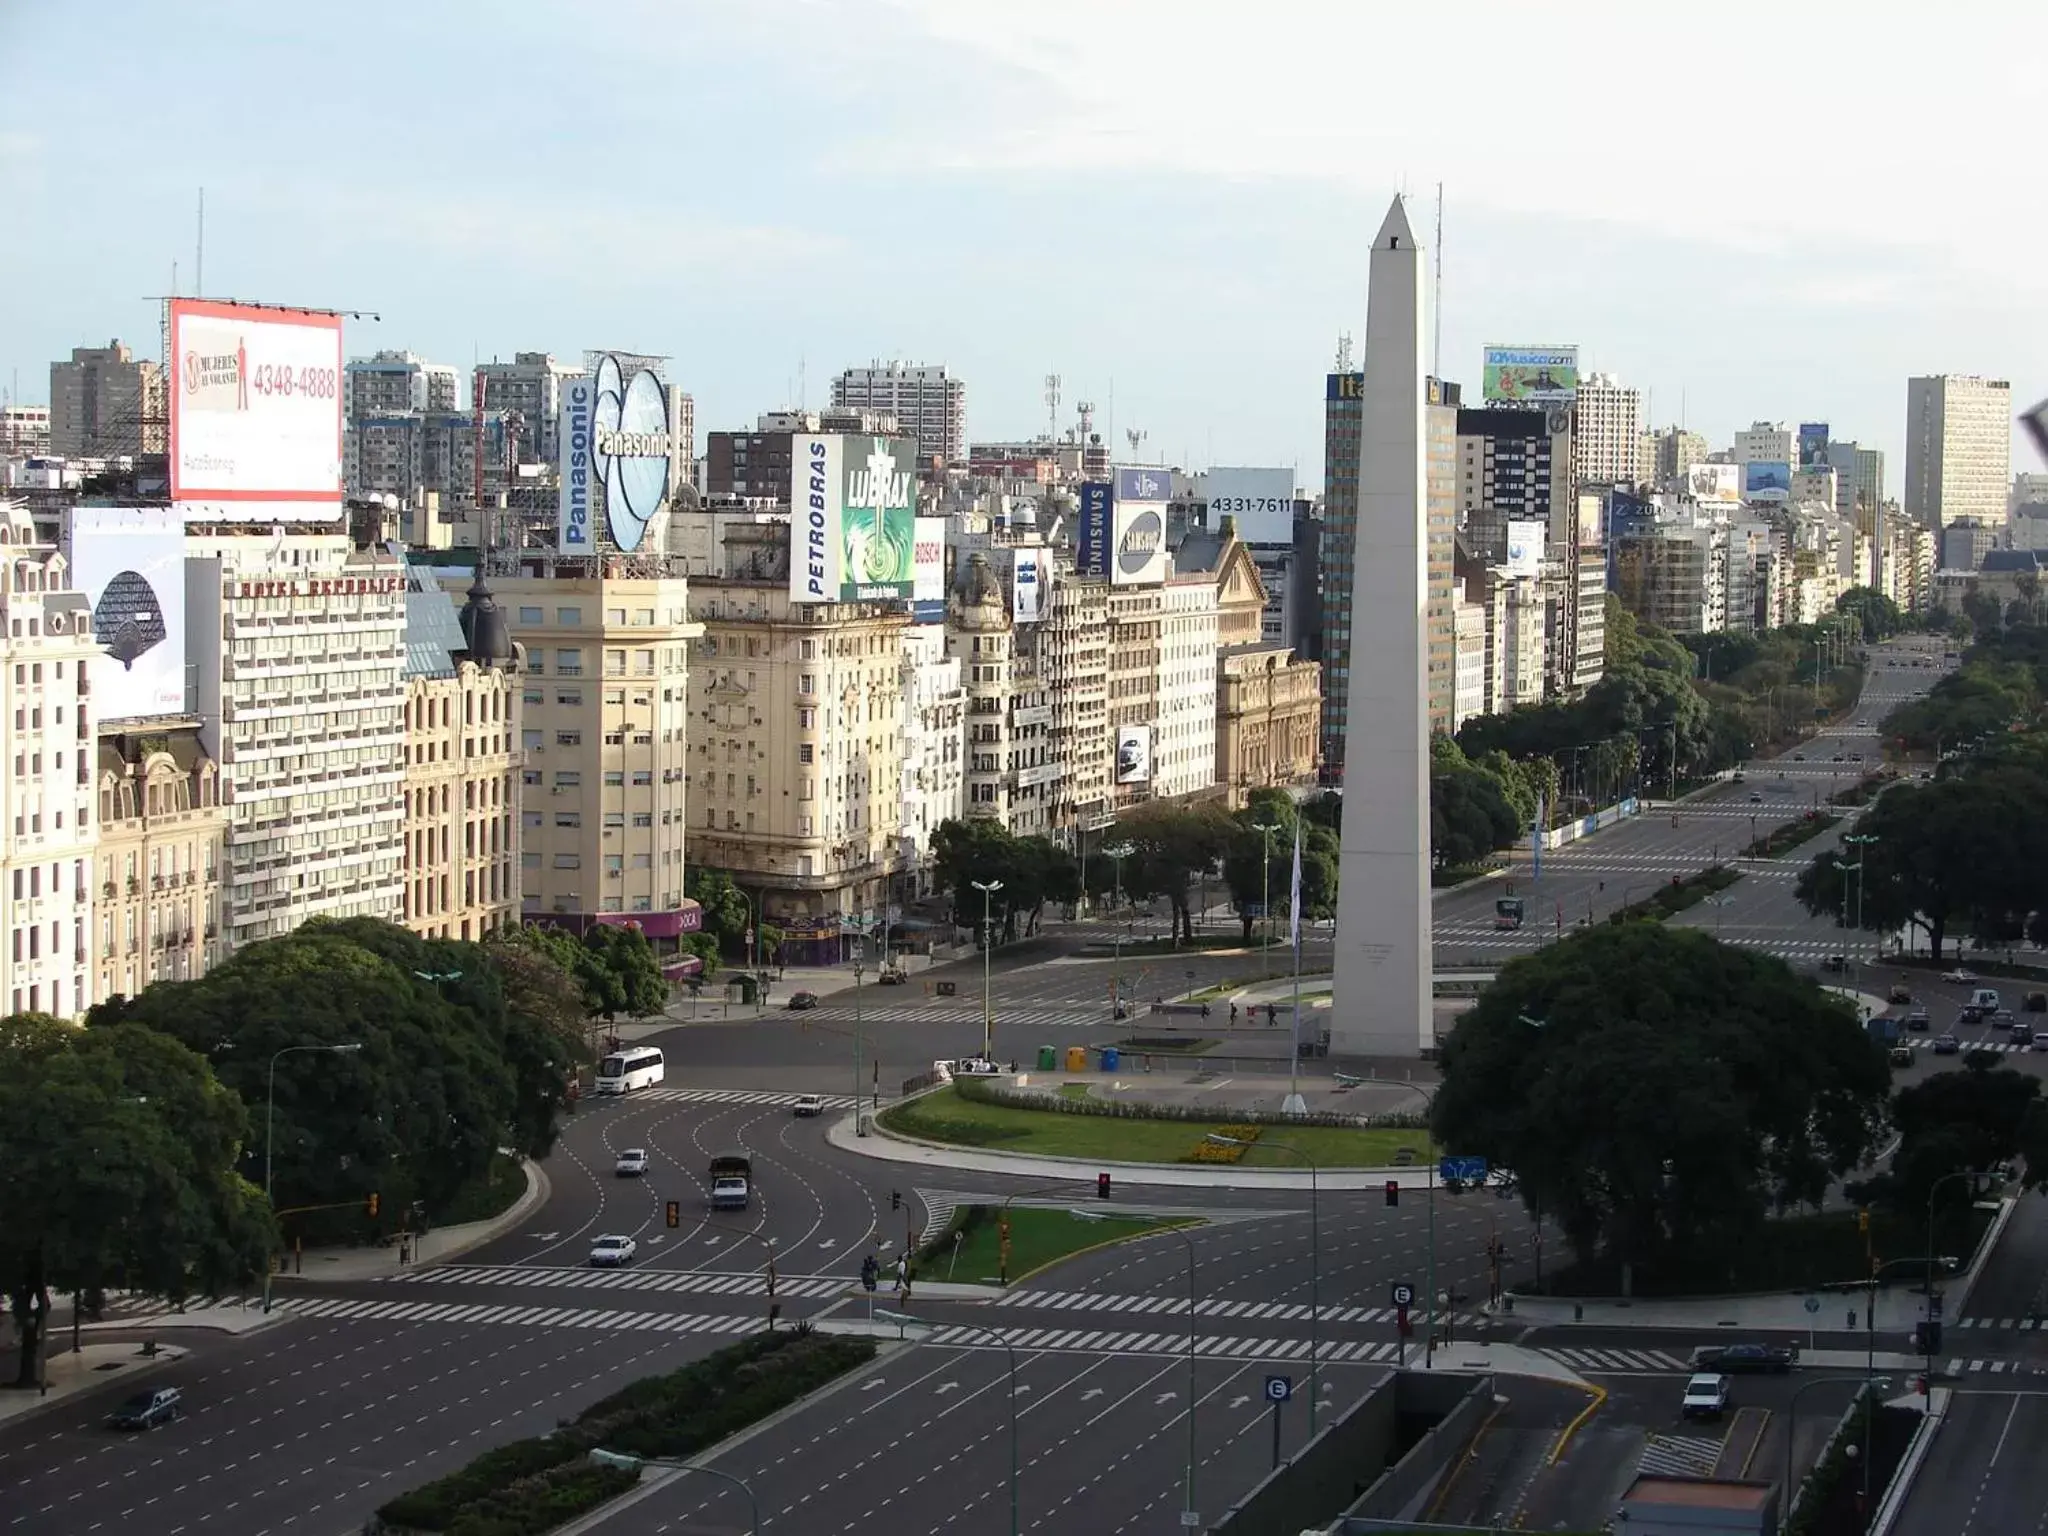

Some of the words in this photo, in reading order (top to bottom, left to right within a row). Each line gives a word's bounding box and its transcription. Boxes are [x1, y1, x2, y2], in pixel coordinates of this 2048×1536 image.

[254, 364, 335, 399] 4348-4888
[594, 422, 673, 458] Panasonic
[566, 386, 588, 544] Panasonic
[848, 469, 912, 508] LUBRAX
[1211, 497, 1291, 513] 4331-7611
[808, 441, 827, 596] PETROBRAS
[1089, 490, 1104, 574] SAMSUNG
[915, 542, 940, 564] BOSCH
[241, 581, 300, 598] HOTEL
[1397, 1289, 1408, 1301] E
[1272, 1382, 1283, 1395] E
